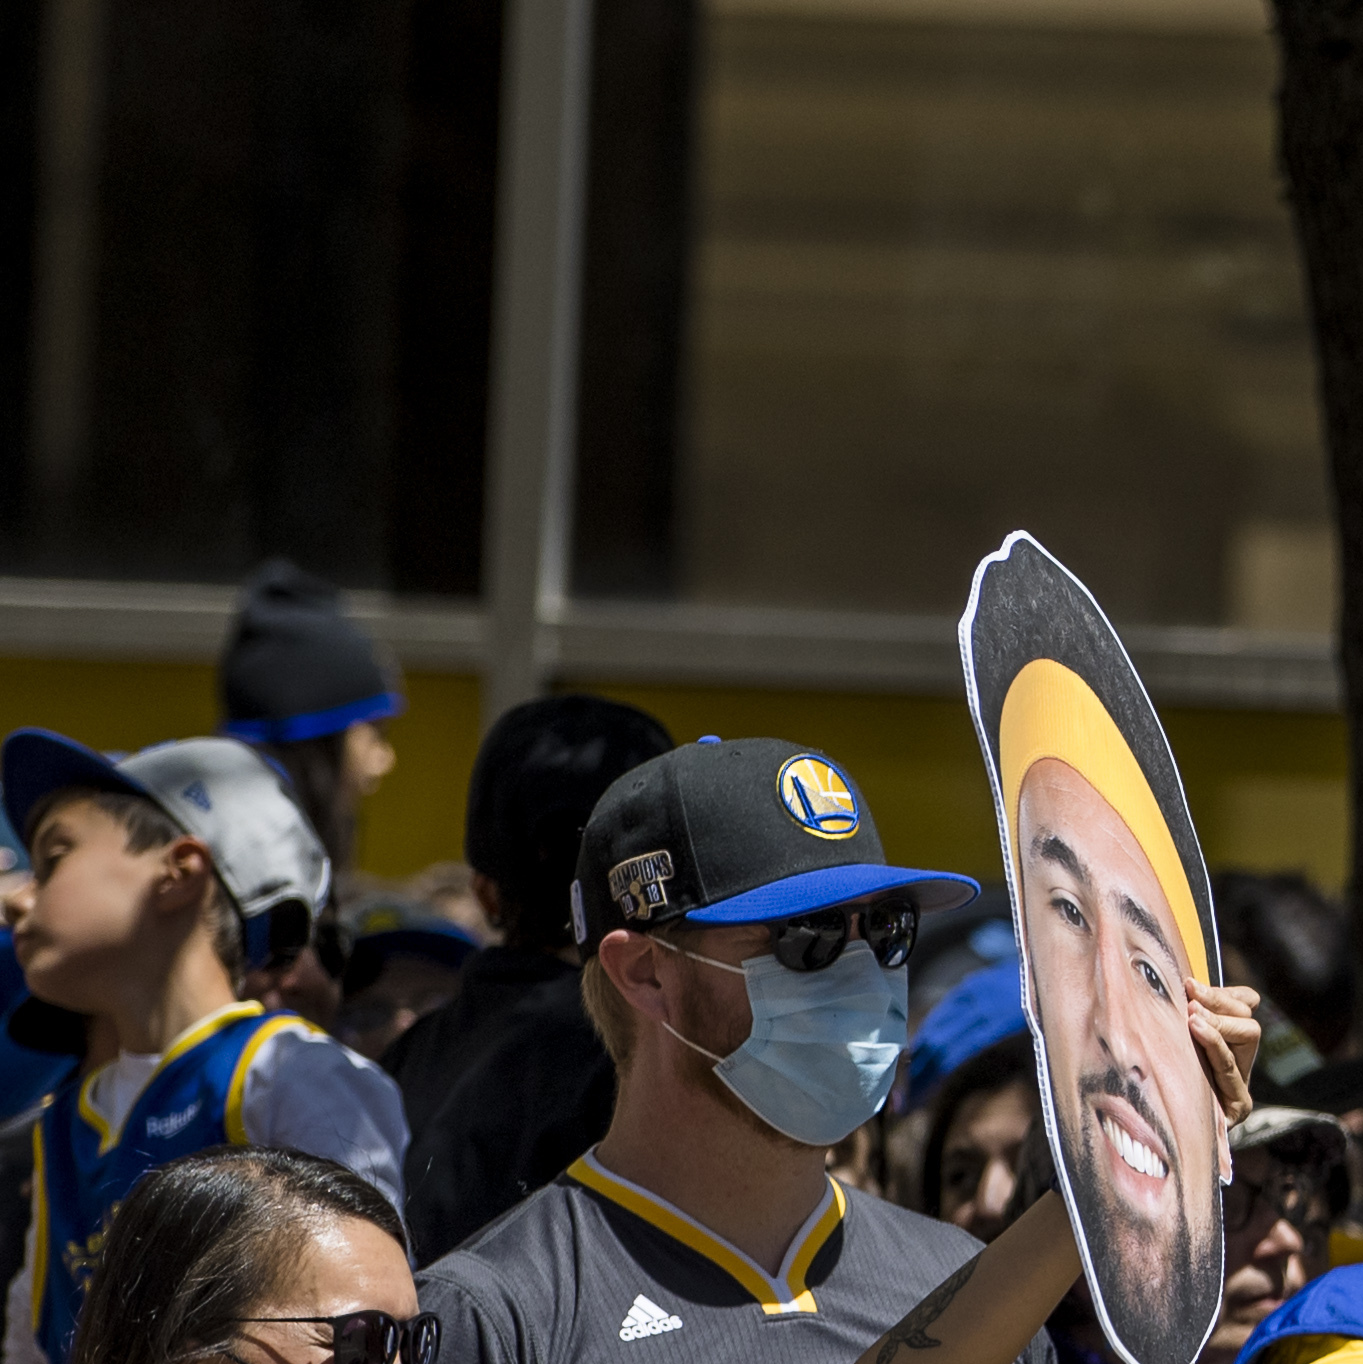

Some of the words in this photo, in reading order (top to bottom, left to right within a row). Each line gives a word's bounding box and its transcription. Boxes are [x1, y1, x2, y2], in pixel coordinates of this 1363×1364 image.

[609, 855, 671, 899] CHAMPIONS
[646, 883, 660, 903] 18
[619, 1315, 683, 1342] adidas
